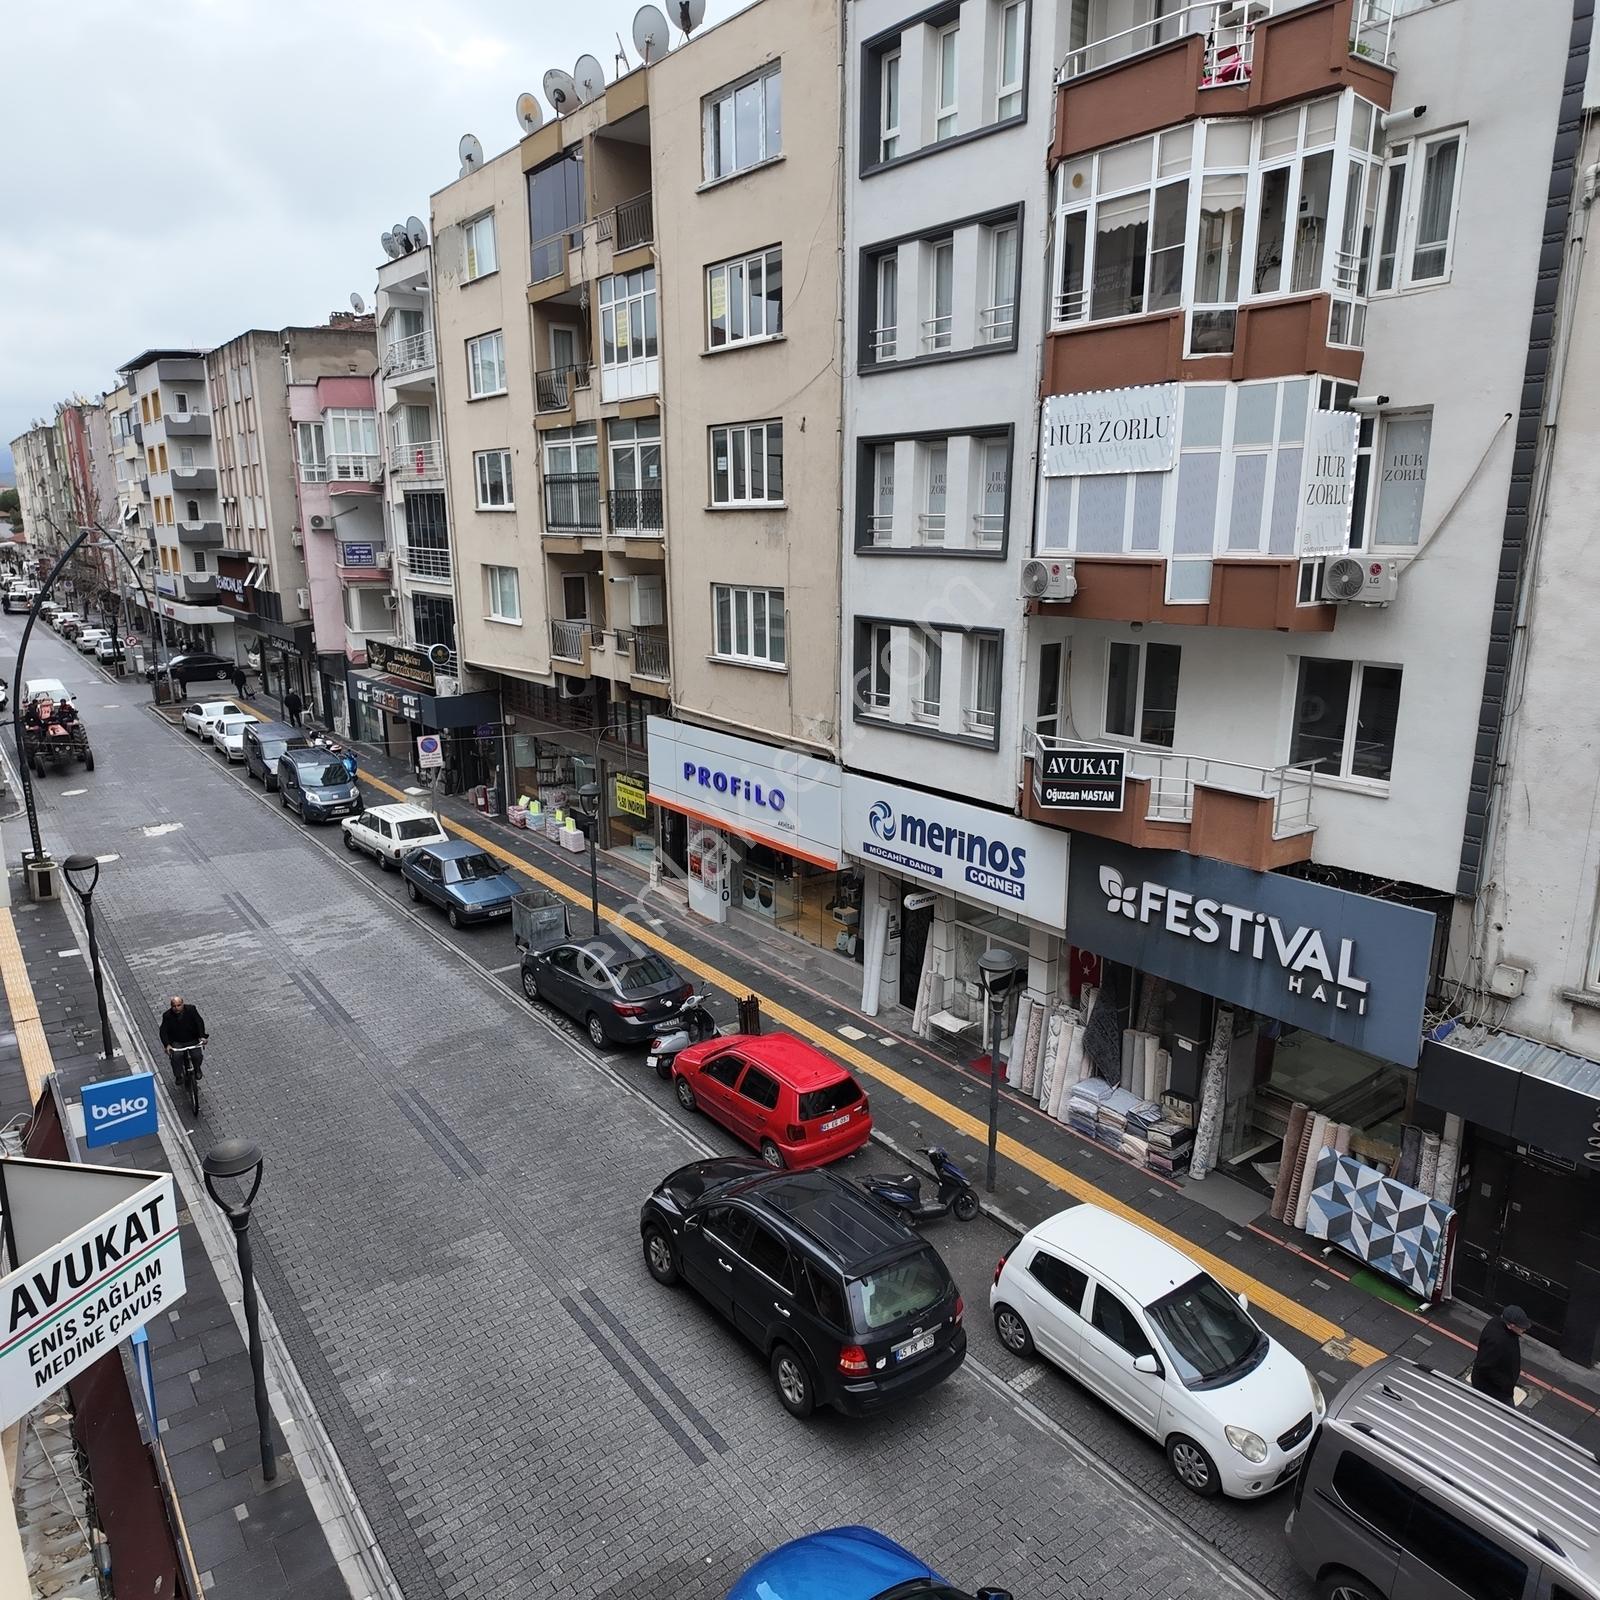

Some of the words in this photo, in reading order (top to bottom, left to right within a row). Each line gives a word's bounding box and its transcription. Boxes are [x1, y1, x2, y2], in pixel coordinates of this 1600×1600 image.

[1049, 422, 1093, 447] NUR
[1098, 415, 1170, 443] ZORLU
[1315, 455, 1345, 477] NUR
[1393, 454, 1423, 468] NUR
[1306, 483, 1351, 506] ZORLU
[1047, 757, 1119, 776] AVUKAT
[1046, 788, 1080, 802] Oğuzcan
[1081, 790, 1114, 802] MASTAN
[869, 845, 908, 865] MÜCAHİT
[909, 857, 936, 876] DANIŞ
[900, 813, 1026, 879] merinos
[969, 869, 1022, 898] CORNER
[1288, 975, 1367, 1016] HALI
[91, 1096, 149, 1120] beko
[8, 1193, 164, 1334] AVUKAT
[27, 1318, 78, 1367] ENİS
[82, 1258, 162, 1328] SAĞLAM
[34, 1325, 106, 1389] MEDİNE
[109, 1284, 163, 1336] ÇAVUŞ
